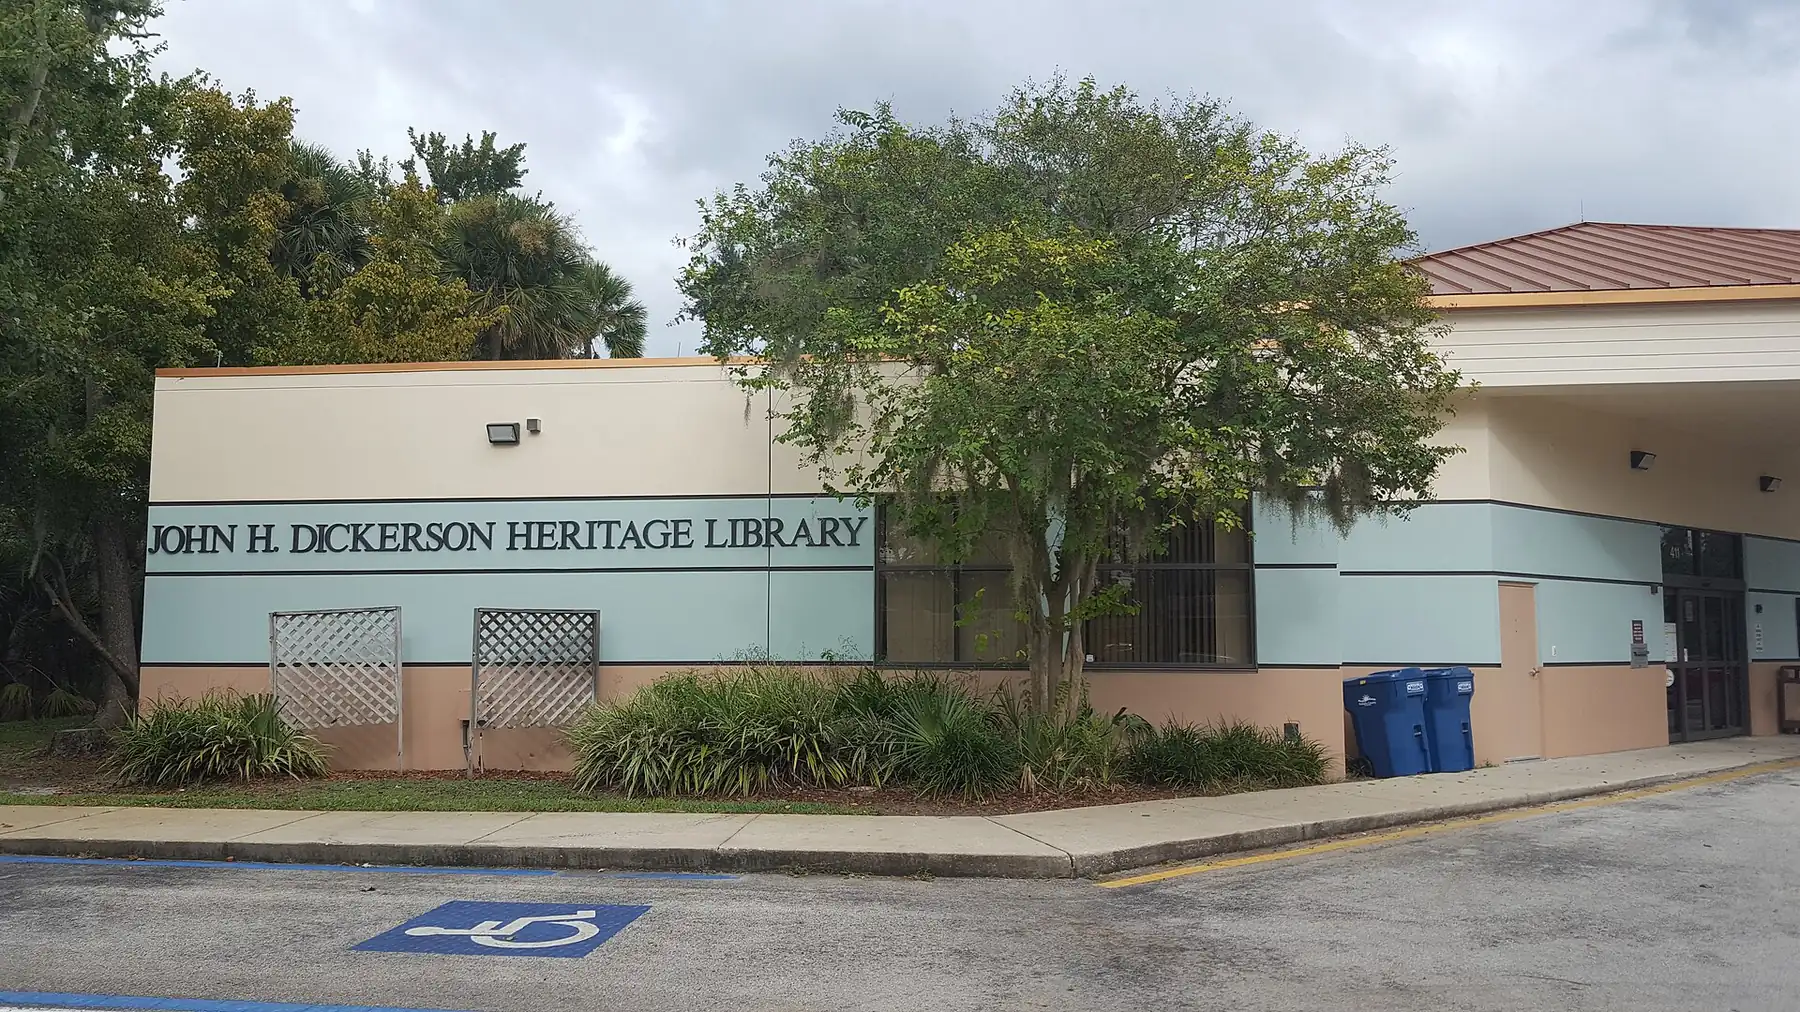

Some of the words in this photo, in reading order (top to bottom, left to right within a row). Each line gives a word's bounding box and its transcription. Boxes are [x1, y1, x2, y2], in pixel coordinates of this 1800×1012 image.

[148, 524, 238, 555] JOHN
[246, 524, 280, 553] H.
[289, 521, 496, 553] DICKERSON
[505, 518, 695, 551] HERITAGE
[704, 516, 868, 548] LIBRARY
